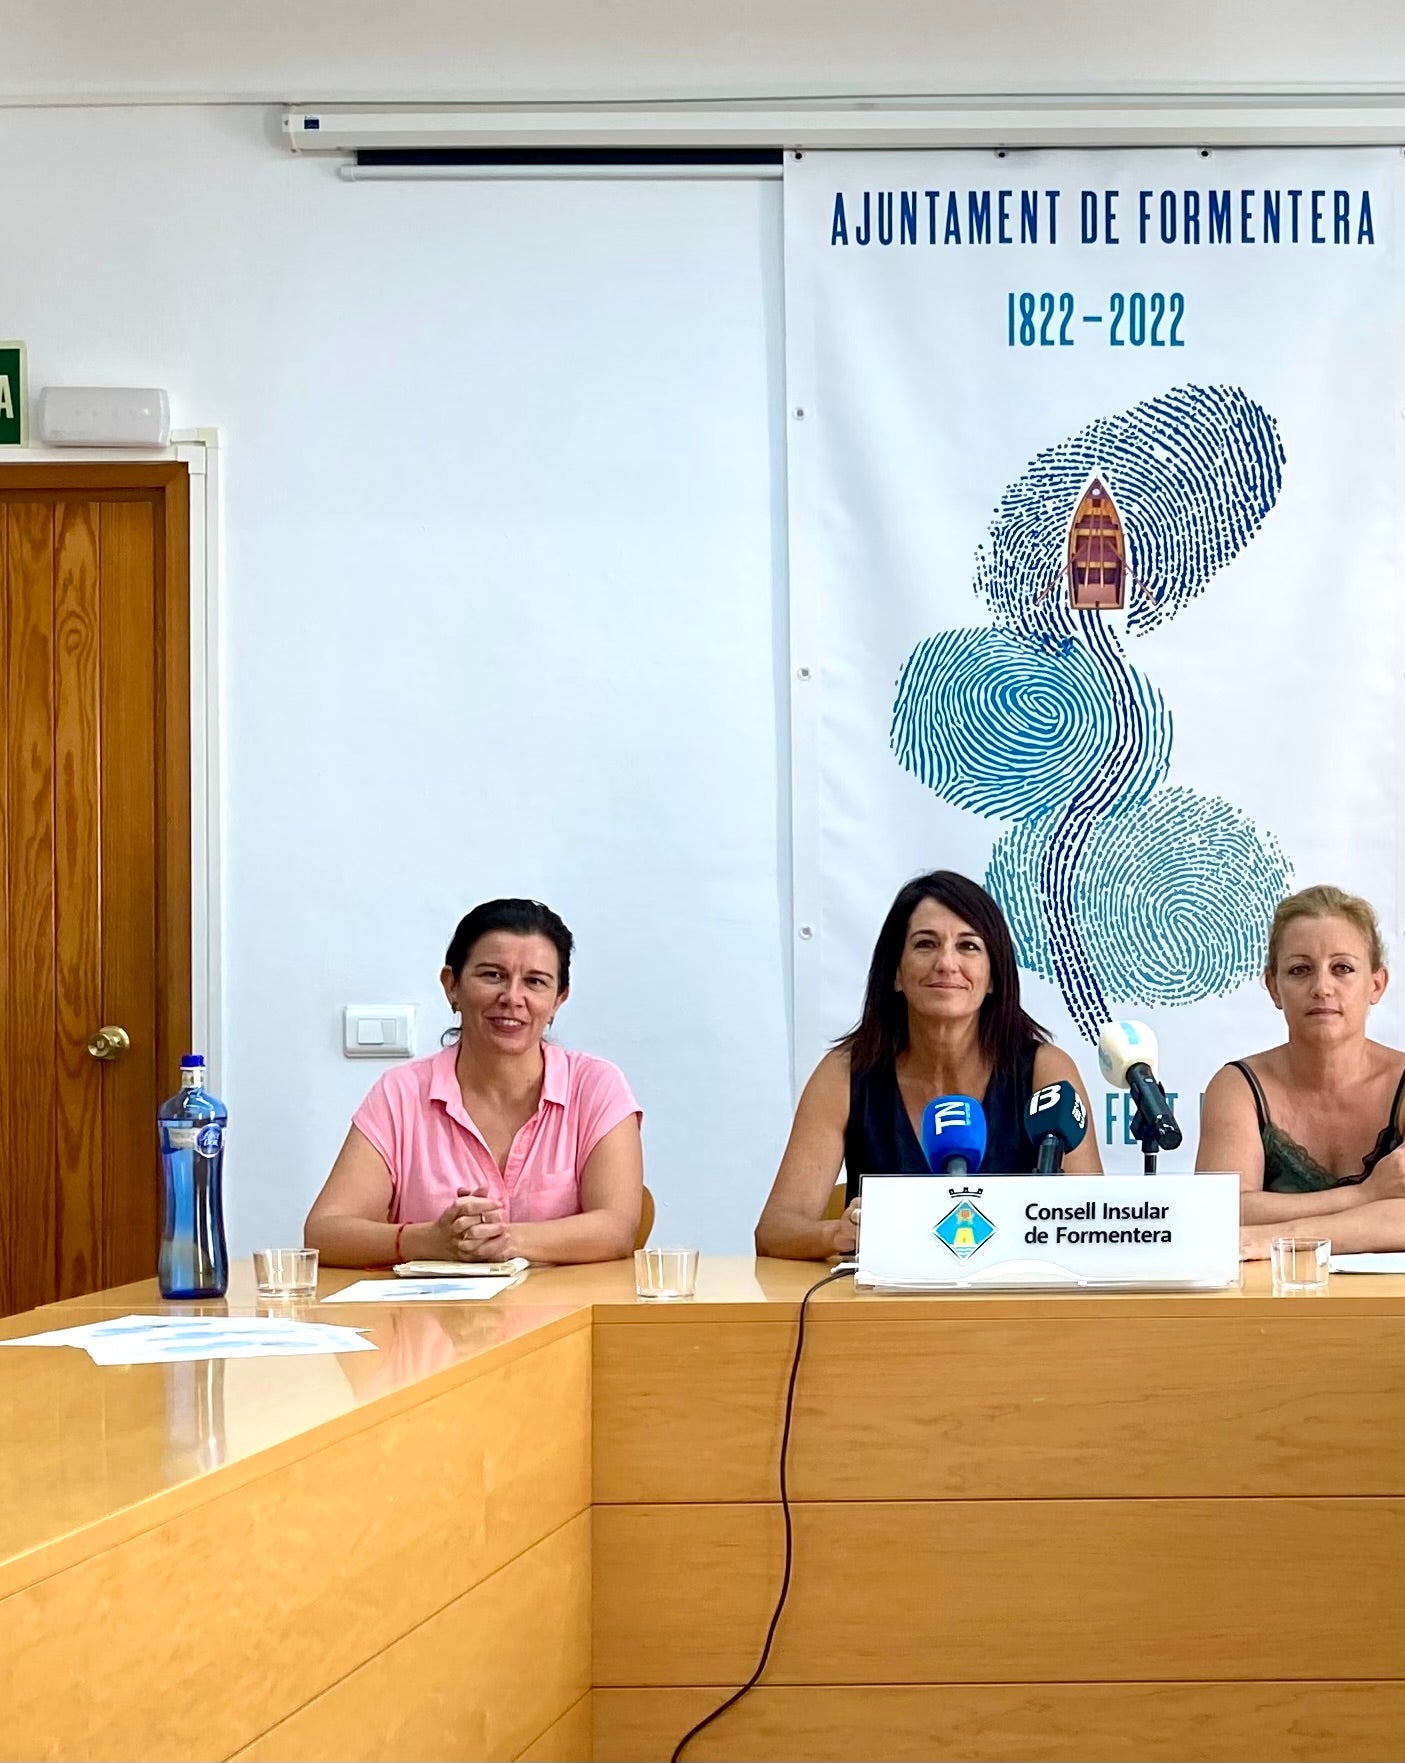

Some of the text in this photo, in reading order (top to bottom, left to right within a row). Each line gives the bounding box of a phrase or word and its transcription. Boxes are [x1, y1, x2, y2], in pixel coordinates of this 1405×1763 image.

[831, 189, 1375, 246] AJUNTAMENT DE FORMENTERA
[1024, 1200, 1170, 1221] Consell Insular
[1024, 1225, 1173, 1244] de Formentera
